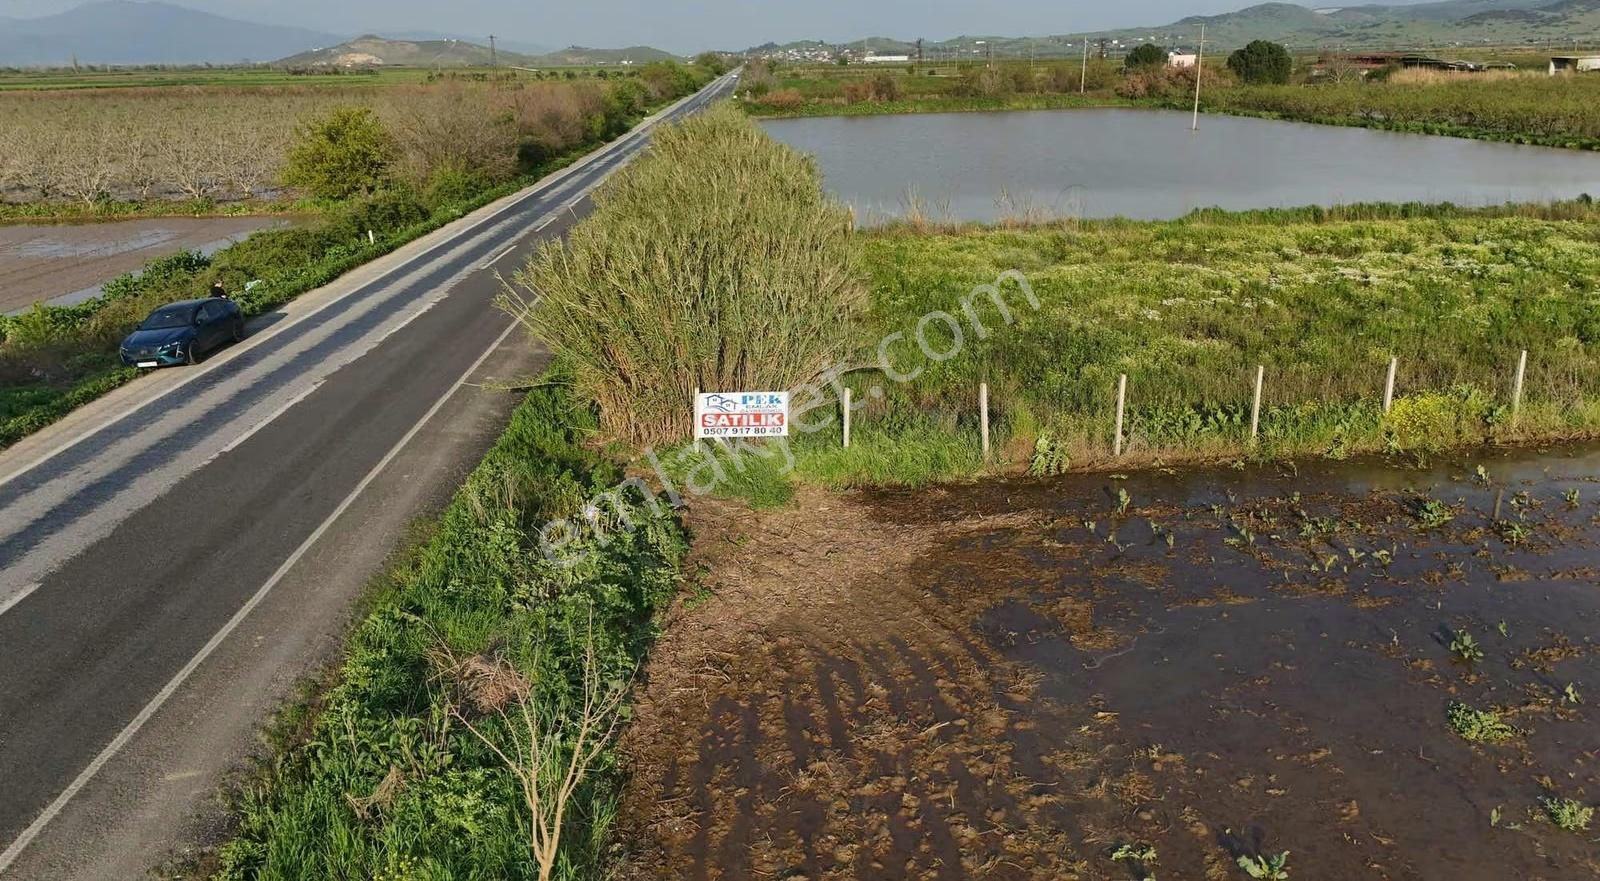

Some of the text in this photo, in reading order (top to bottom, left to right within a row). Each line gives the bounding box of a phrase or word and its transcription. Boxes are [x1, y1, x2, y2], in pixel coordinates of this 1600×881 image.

[742, 395, 782, 404] PEK
[703, 414, 781, 426] SATILIK
[732, 427, 751, 435] 917
